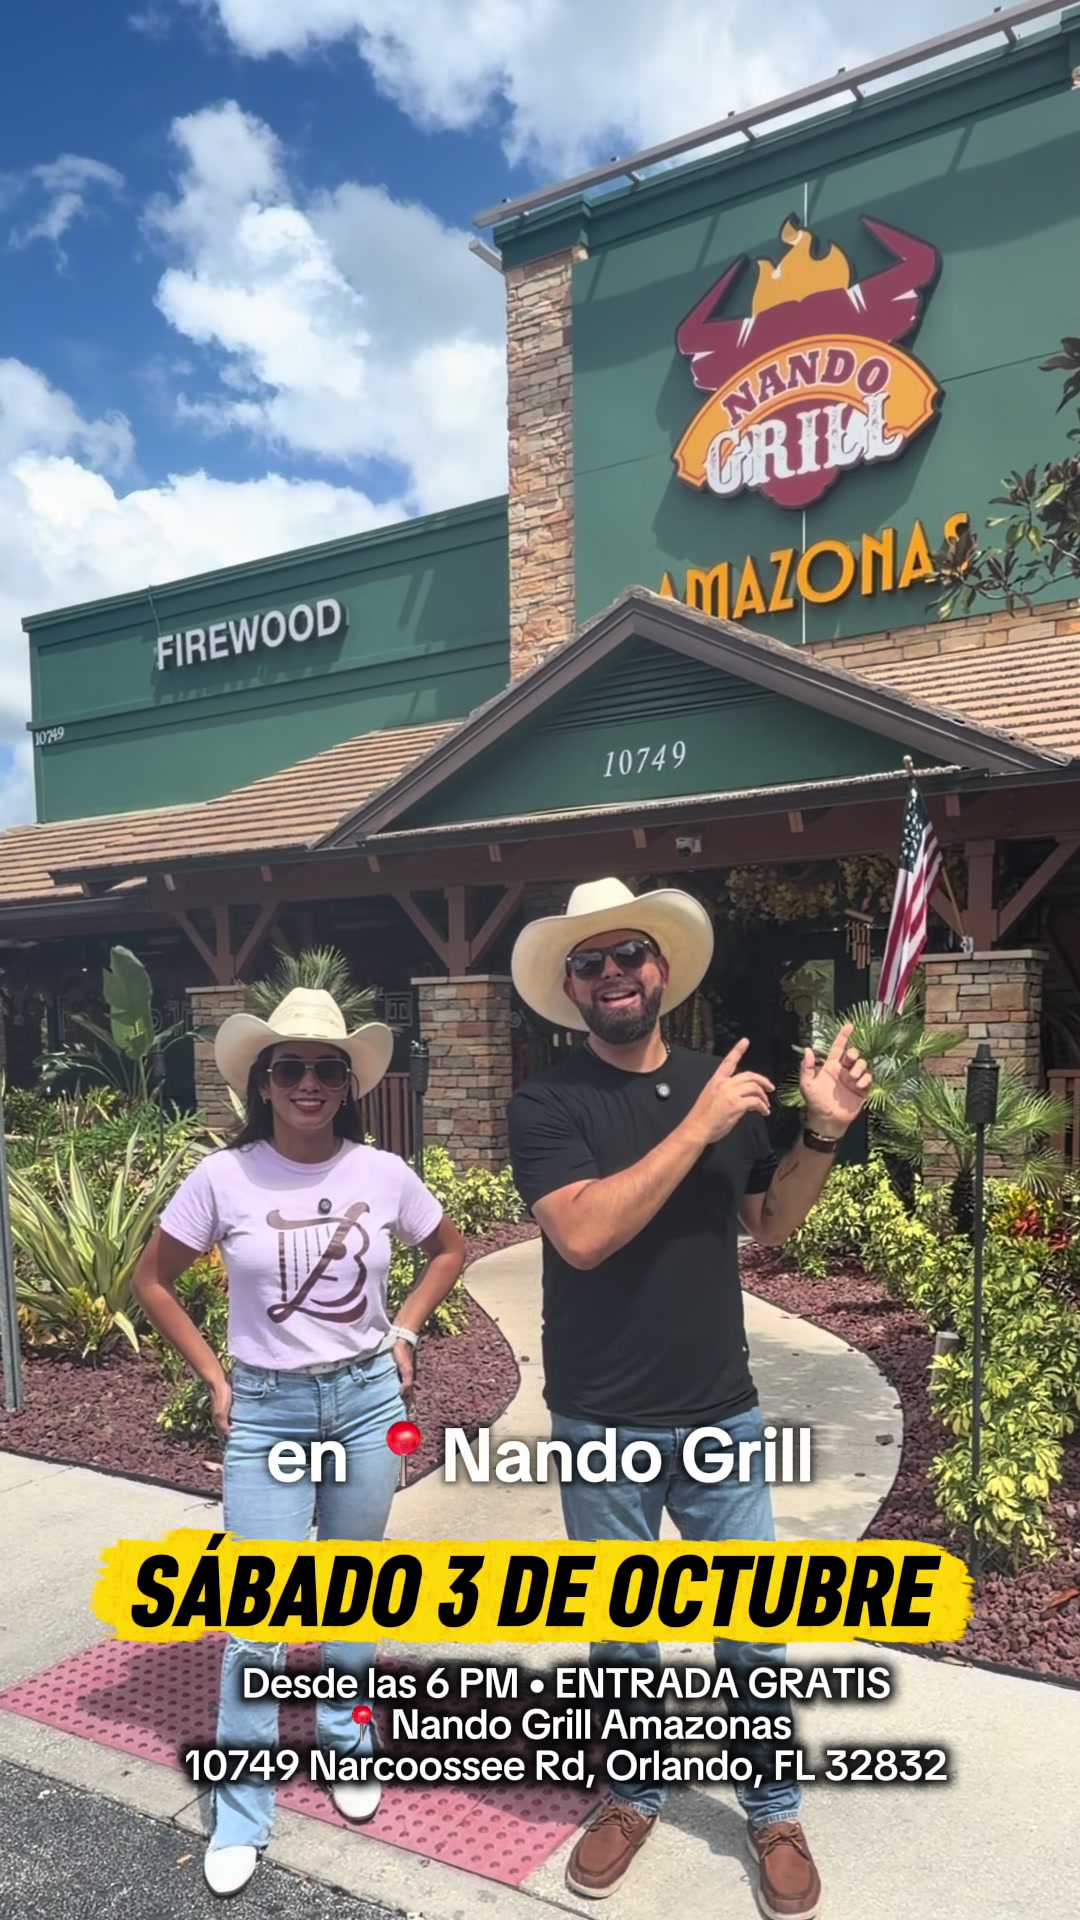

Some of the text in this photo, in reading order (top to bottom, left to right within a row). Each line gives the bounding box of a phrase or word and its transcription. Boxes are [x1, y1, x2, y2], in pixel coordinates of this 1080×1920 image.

[720, 348, 891, 428] NANDO
[704, 392, 905, 494] GRILL
[157, 598, 342, 671] FIREWOOD
[35, 726, 64, 746] 10749
[603, 740, 686, 777] 10749
